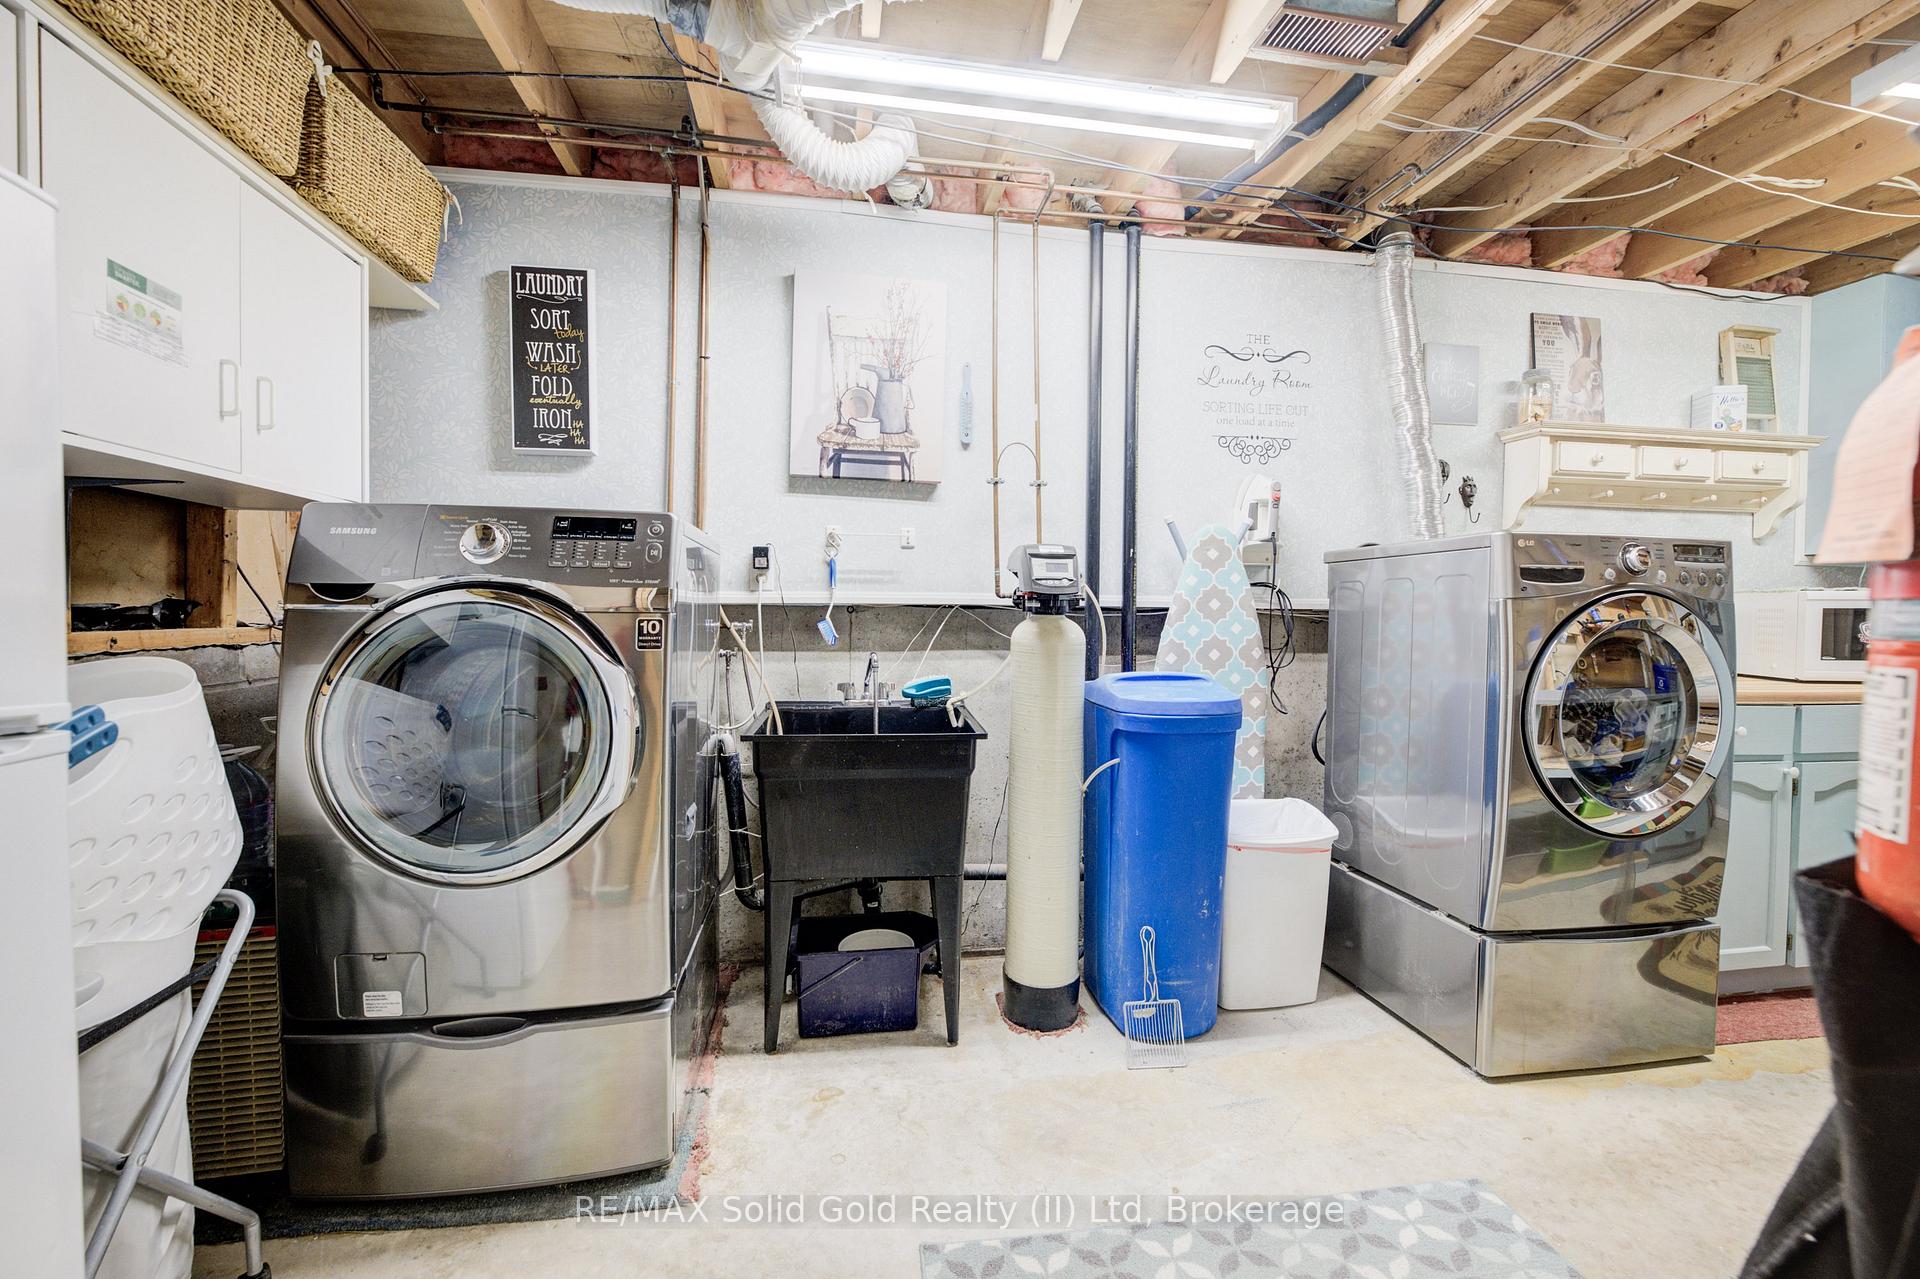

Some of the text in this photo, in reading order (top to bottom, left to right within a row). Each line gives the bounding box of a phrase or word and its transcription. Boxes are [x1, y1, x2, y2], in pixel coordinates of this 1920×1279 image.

[515, 272, 584, 297] LAUNDRY
[530, 309, 571, 330] SORT
[554, 323, 585, 342] today
[1247, 333, 1271, 345] THE
[525, 341, 576, 364] WASH
[539, 363, 570, 374] LATER
[531, 375, 572, 397] FOLD
[1197, 365, 1311, 397] Laundry Room
[529, 393, 583, 410] eventually
[1203, 401, 1309, 417] SORTING LIFE OUT
[533, 408, 572, 429] IRON
[1216, 418, 1233, 426] one
[1235, 415, 1255, 426] load
[1257, 417, 1267, 427] at
[1275, 417, 1295, 428] time
[329, 526, 377, 535] SAMSUNG
[639, 620, 660, 634] 10
